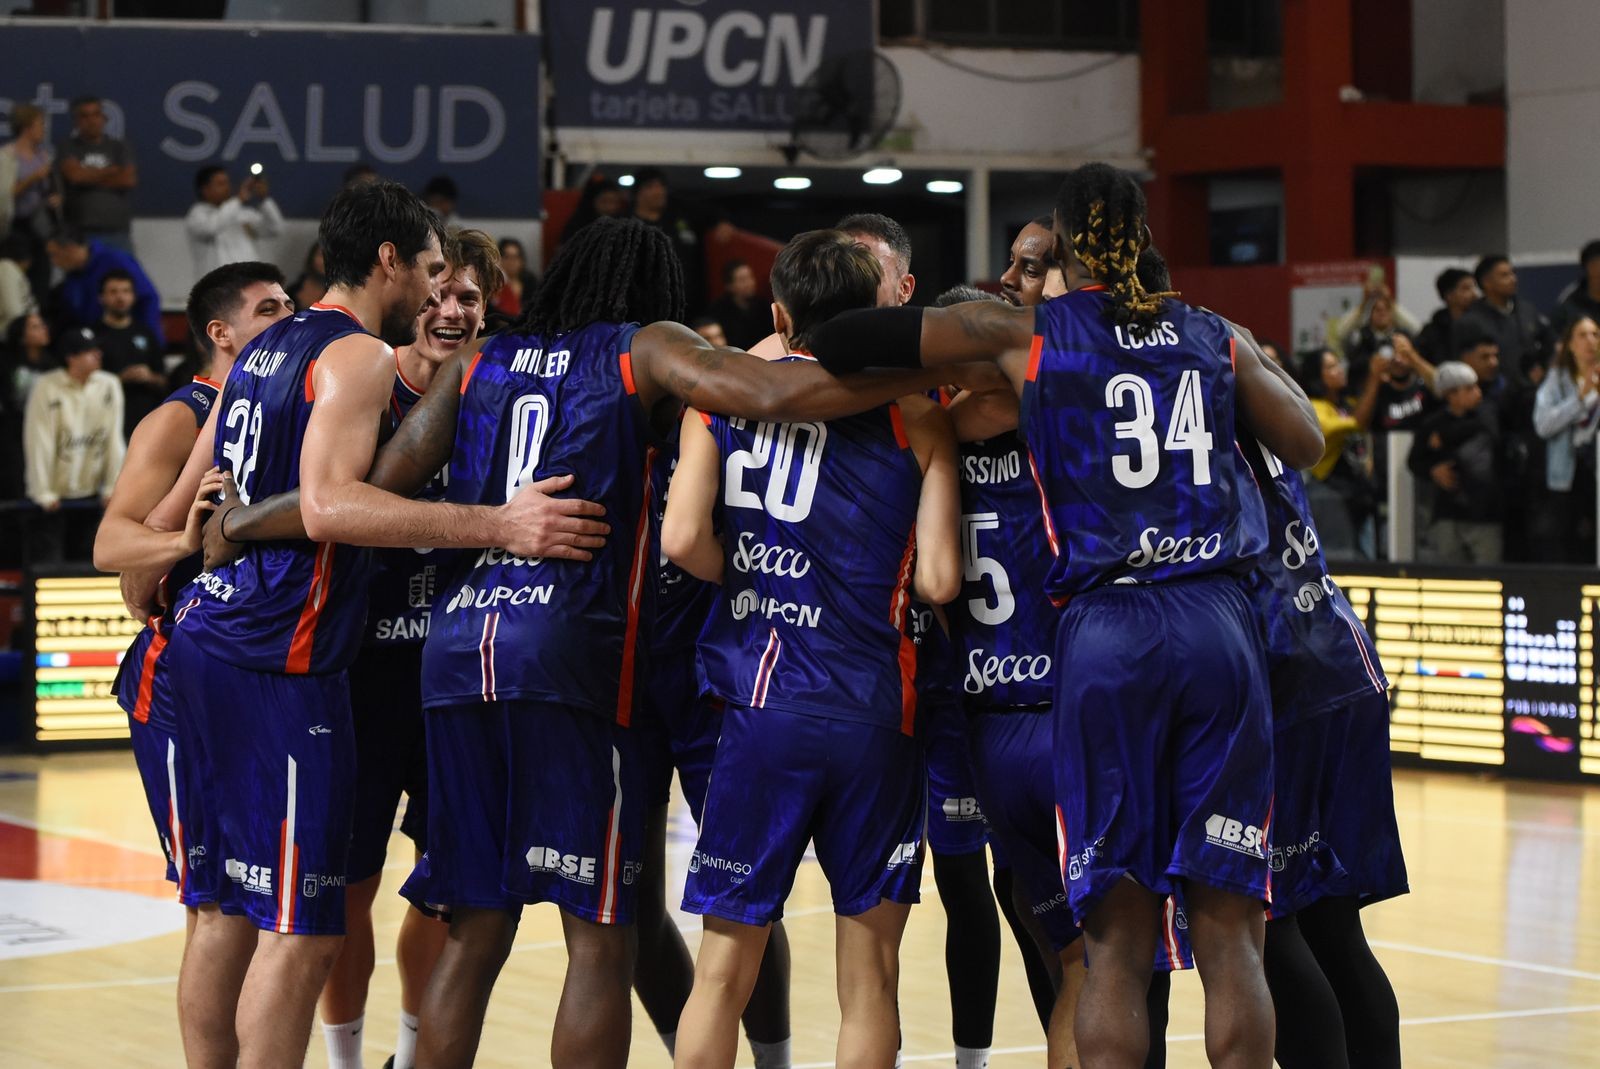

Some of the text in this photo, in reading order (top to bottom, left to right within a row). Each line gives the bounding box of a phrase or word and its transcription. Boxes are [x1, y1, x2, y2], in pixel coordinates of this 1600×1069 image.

[586, 10, 827, 88] UPCN
[160, 81, 507, 163] SALUD
[591, 91, 699, 124] tarjeta
[505, 394, 549, 504] 0
[1105, 370, 1213, 489] 34
[725, 416, 828, 523] 20
[961, 450, 1021, 484] SSINO
[733, 531, 811, 579] Secco
[962, 512, 1016, 626] 5
[1127, 527, 1222, 568] Secco
[474, 584, 555, 609] UPCN
[964, 648, 1052, 694] Secco
[235, 861, 272, 889] BSE
[544, 847, 596, 879] BSE
[702, 853, 752, 875] SANTIAGO
[1032, 893, 1066, 915] ANTIAG
